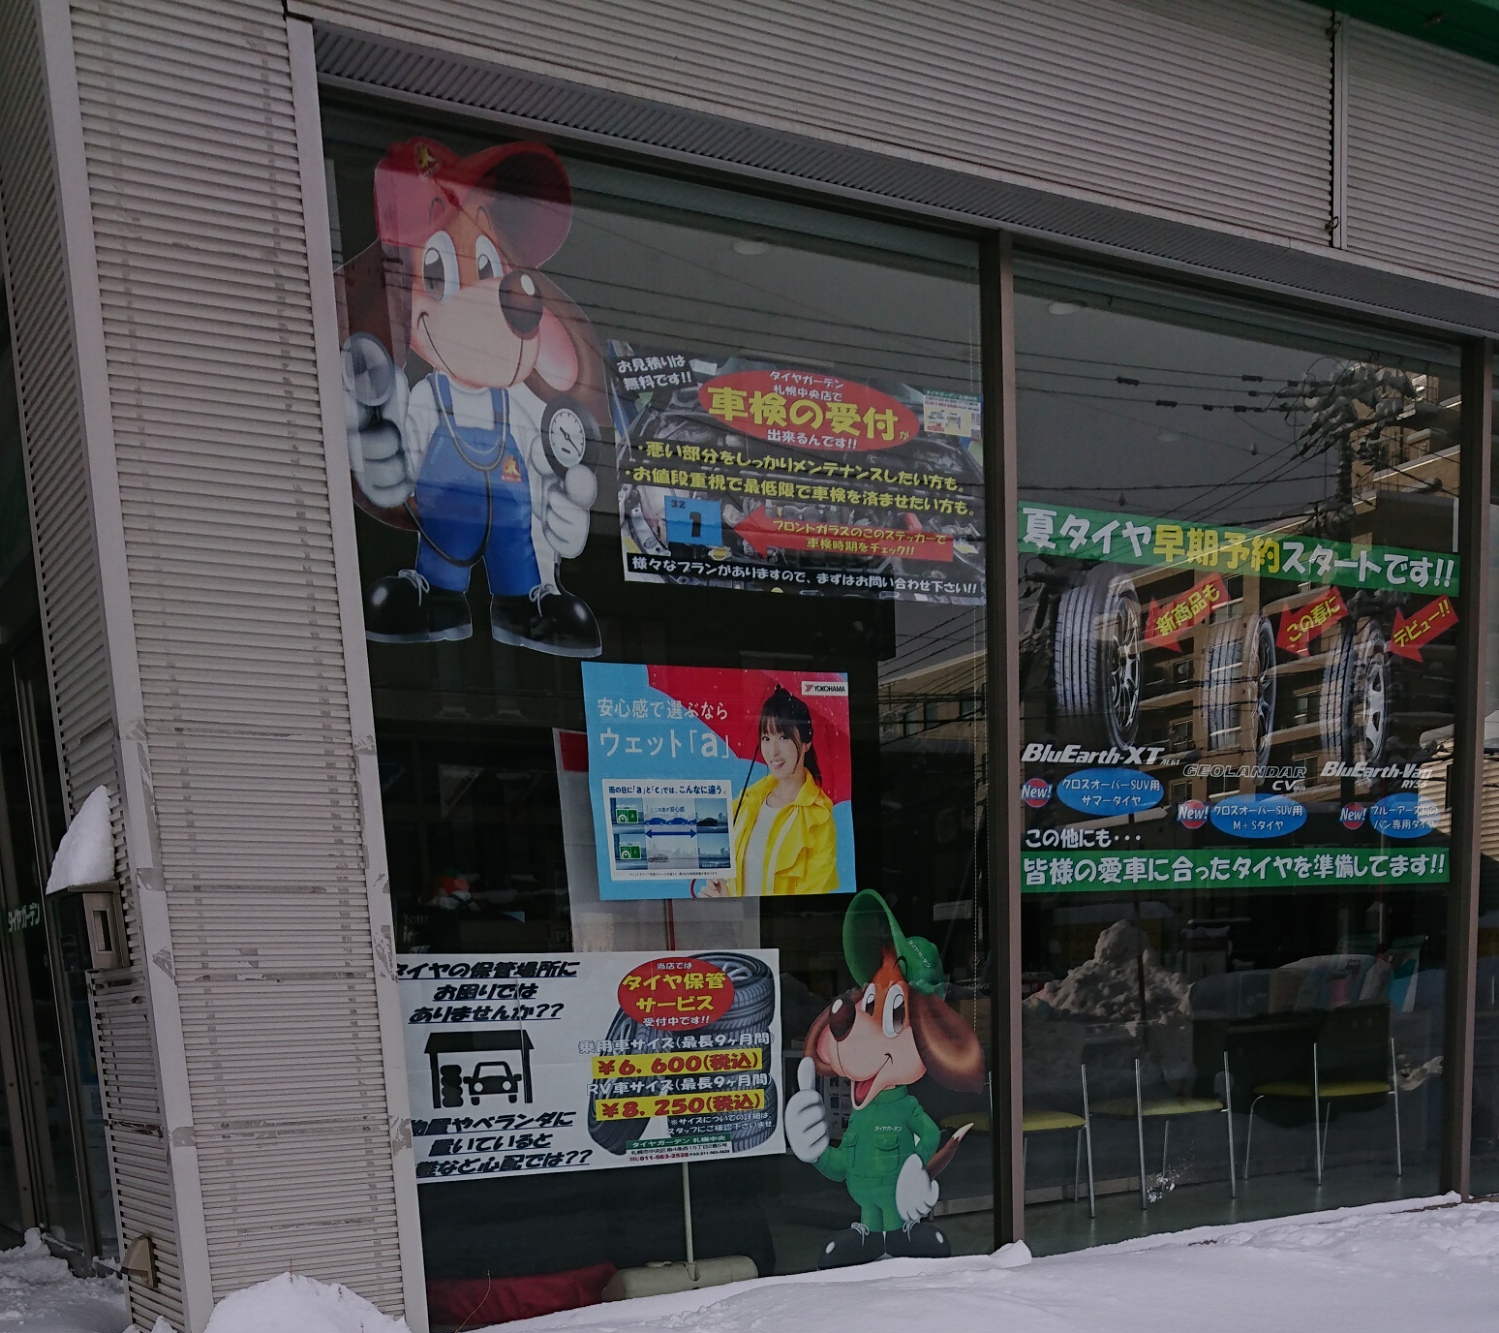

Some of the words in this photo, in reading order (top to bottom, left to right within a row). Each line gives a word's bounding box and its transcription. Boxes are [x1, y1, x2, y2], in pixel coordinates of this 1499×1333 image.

[616, 354, 686, 374] お見積りは
[623, 371, 692, 391] 無料です!!
[769, 370, 844, 390] タイヤガーデン
[773, 384, 842, 402] 札幌中央店で
[767, 429, 857, 449] 出来るんです!!
[671, 499, 686, 509] 32
[689, 511, 702, 537] 1
[773, 520, 948, 545] フロントガラスのこのステッカーで
[807, 538, 915, 556] 車検時期をチェック!!
[1022, 507, 1454, 588] 夏タイヤ早期予約スタートです!!
[1155, 583, 1220, 636] 新商品も
[1287, 596, 1340, 642] この春に
[1393, 599, 1451, 648] デビュー!!
[597, 697, 729, 720] 安心感で選ぶなら
[600, 727, 730, 759] ウェット「a」
[1021, 743, 1165, 765] BluEarth-XT
[1182, 763, 1307, 779] GEOLANDAR
[1319, 760, 1433, 780] BluEarth-Van
[1021, 783, 1052, 799] New!
[1062, 778, 1160, 791] クロスオーバーSUV用
[1272, 780, 1296, 791] CV
[1082, 795, 1142, 807] サマータイヤ
[1177, 805, 1209, 821] New!
[1213, 805, 1303, 817] クロスオーバーSUV用
[1339, 808, 1367, 822] New!
[1023, 854, 1446, 886] 皆様の愛車に合ったタイヤを準備してます!!
[657, 962, 692, 970] 当店では
[622, 972, 727, 991] タイヤ保管
[433, 983, 539, 1000] お困りでは
[409, 1003, 564, 1023] ありませんか??
[636, 995, 714, 1013] サービス
[643, 1016, 710, 1027] 受付中です!!
[632, 1138, 691, 1148] タイヤガーデン
[693, 1135, 726, 1143] 札幌中央
